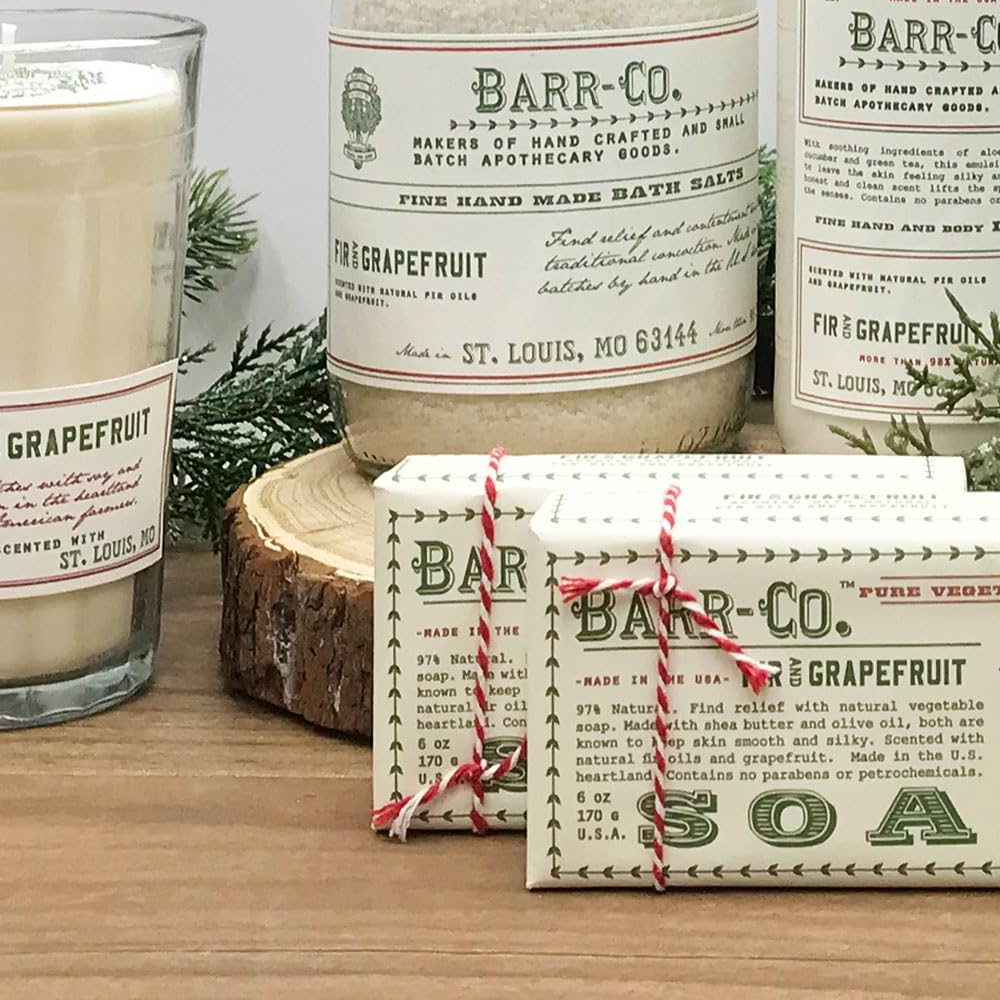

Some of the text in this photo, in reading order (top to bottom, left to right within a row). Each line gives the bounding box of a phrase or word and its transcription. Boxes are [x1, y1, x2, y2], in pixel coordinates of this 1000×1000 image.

[815, 79, 853, 92] MAKERS
[862, 83, 876, 93] OF
[885, 85, 917, 95] HAND
[926, 86, 983, 96] CRAFTED
[815, 96, 989, 113] BATCH APOTHECARY GOODS.
[413, 113, 745, 151] MAKERS OF HAND CRAFTED AND SMALL
[414, 144, 679, 166] BATCH APOTHECARY GOODS.
[399, 168, 744, 207] FINE HAND MADE BATH SALTS
[815, 216, 846, 227] FINE
[851, 219, 894, 231] HAND
[901, 224, 936, 233] AND
[942, 223, 983, 234] BODY
[545, 222, 681, 249] Find relief and
[334, 238, 349, 267] FIR
[361, 247, 486, 278] GRAPEFRUIT
[813, 313, 851, 339] FIR AND
[462, 342, 498, 364] ST.
[508, 341, 583, 364] LOUIS,
[594, 334, 627, 359] MO
[635, 319, 697, 354] 63144
[813, 370, 887, 397] ST. LOUIS,
[8, 407, 150, 460] GRAPEFRUIT
[71, 530, 105, 546] WITH
[60, 526, 155, 570] ST. LOUIS, MO
[859, 585, 921, 598] PURE
[495, 626, 520, 636] THE
[632, 675, 648, 686] IN
[789, 658, 966, 687] AND GRAPEFRUIT
[576, 699, 984, 716] 97% Find relief with natural vegetable
[576, 714, 911, 732] soap. butter olive oil,
[858, 766, 984, 783] petrochemicals.
[577, 792, 611, 804] 6 oz
[577, 810, 602, 821] 170
[577, 828, 626, 841] U.S.A.
